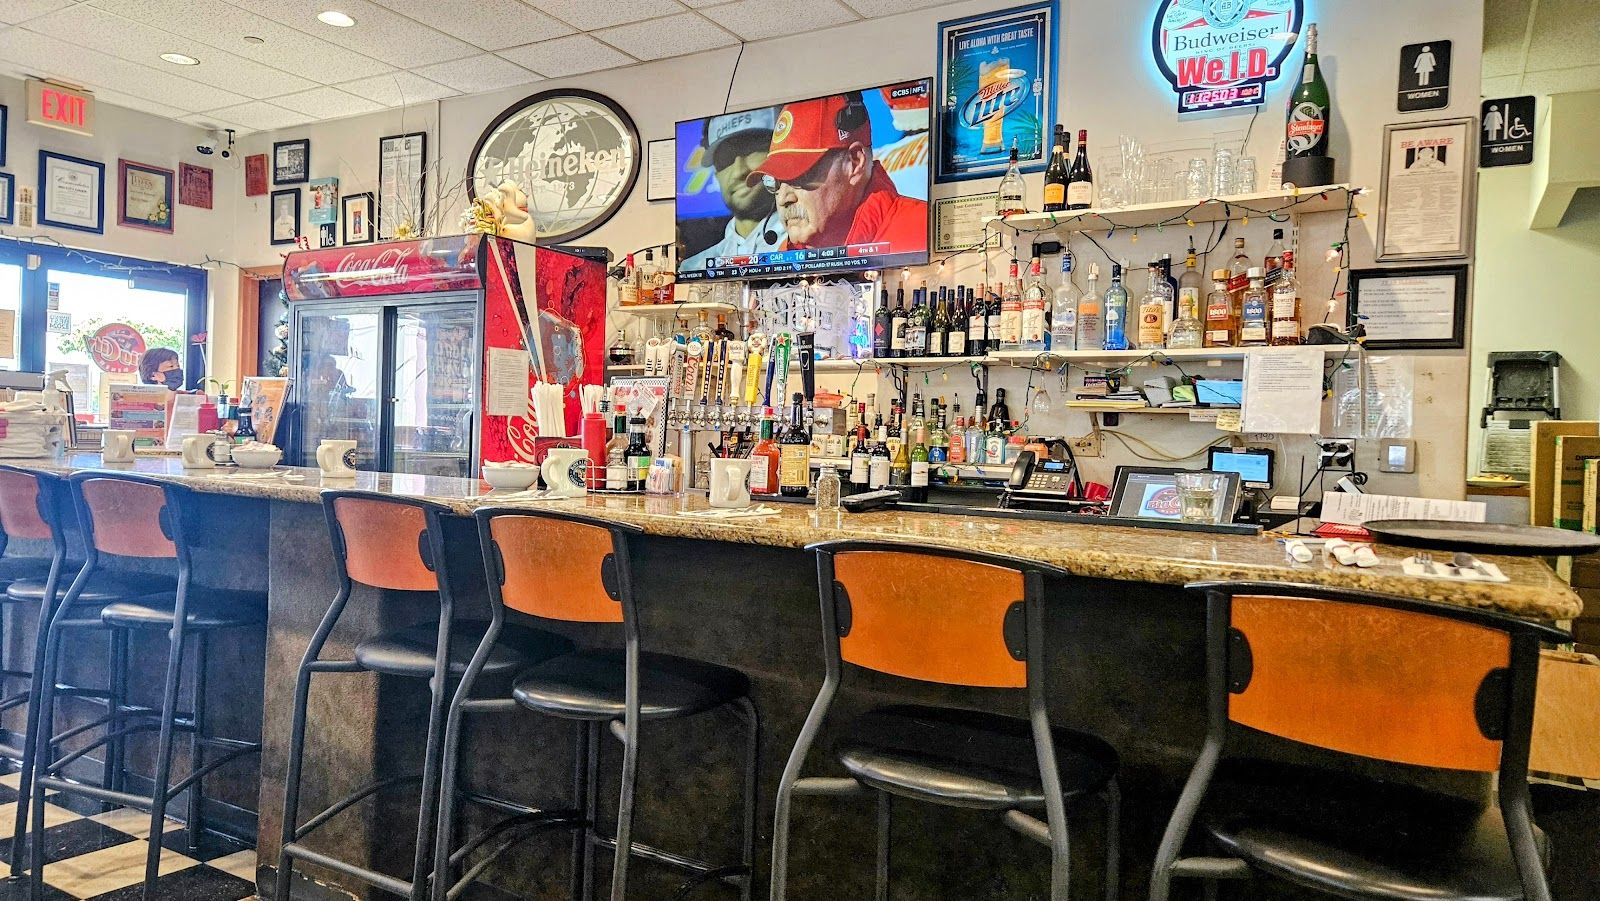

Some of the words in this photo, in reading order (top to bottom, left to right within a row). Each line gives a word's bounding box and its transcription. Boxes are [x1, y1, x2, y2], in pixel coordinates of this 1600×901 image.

[959, 40, 970, 50] LIVE
[970, 37, 987, 49] ALOHA
[987, 34, 1001, 45] WITH
[1001, 31, 1017, 42] GREAT
[1017, 28, 1034, 39] TASTE
[1174, 26, 1279, 51] Budweiser
[1177, 55, 1224, 87] We
[1229, 48, 1276, 79] I.D.
[897, 88, 909, 96] CBS
[979, 82, 1010, 99] Miller
[1407, 89, 1440, 100] WOMEN
[42, 88, 86, 128] EXIT
[716, 114, 752, 137] CHIEFS
[1290, 120, 1323, 135] Steinlager
[1417, 138, 1454, 147] AWARE
[1491, 144, 1524, 153] WOMEN
[508, 146, 628, 180] Heineken
[336, 247, 415, 289] Coca-Cola
[748, 256, 758, 264] 20
[645, 358, 653, 372] Lite
[686, 356, 699, 392] Coors
